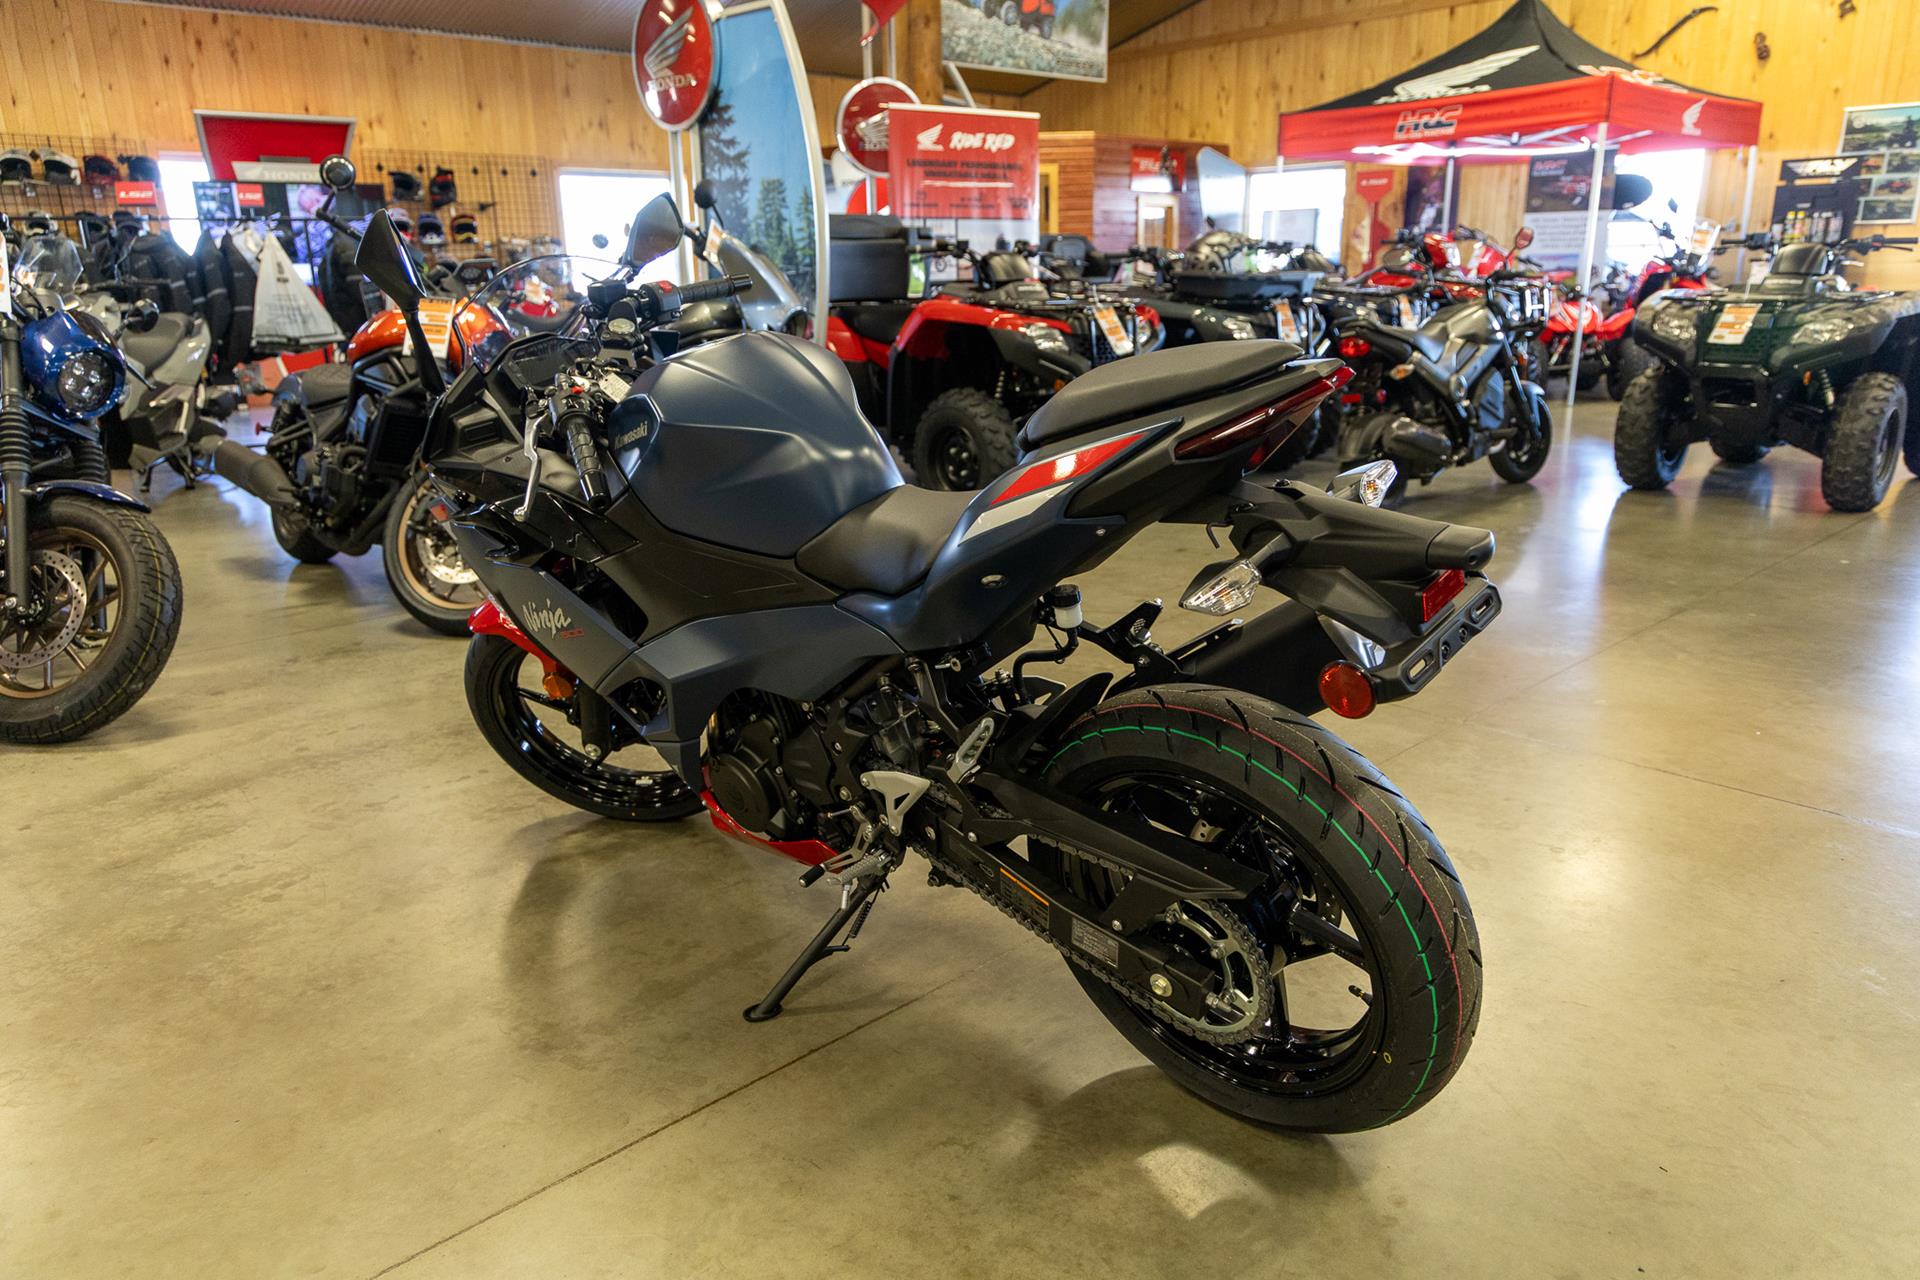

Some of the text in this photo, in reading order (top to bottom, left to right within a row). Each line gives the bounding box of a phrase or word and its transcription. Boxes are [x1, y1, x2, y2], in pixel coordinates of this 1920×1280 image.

[1394, 104, 1463, 133] HRC
[949, 130, 1015, 153] RIDE RED
[522, 598, 571, 639] Ninja
